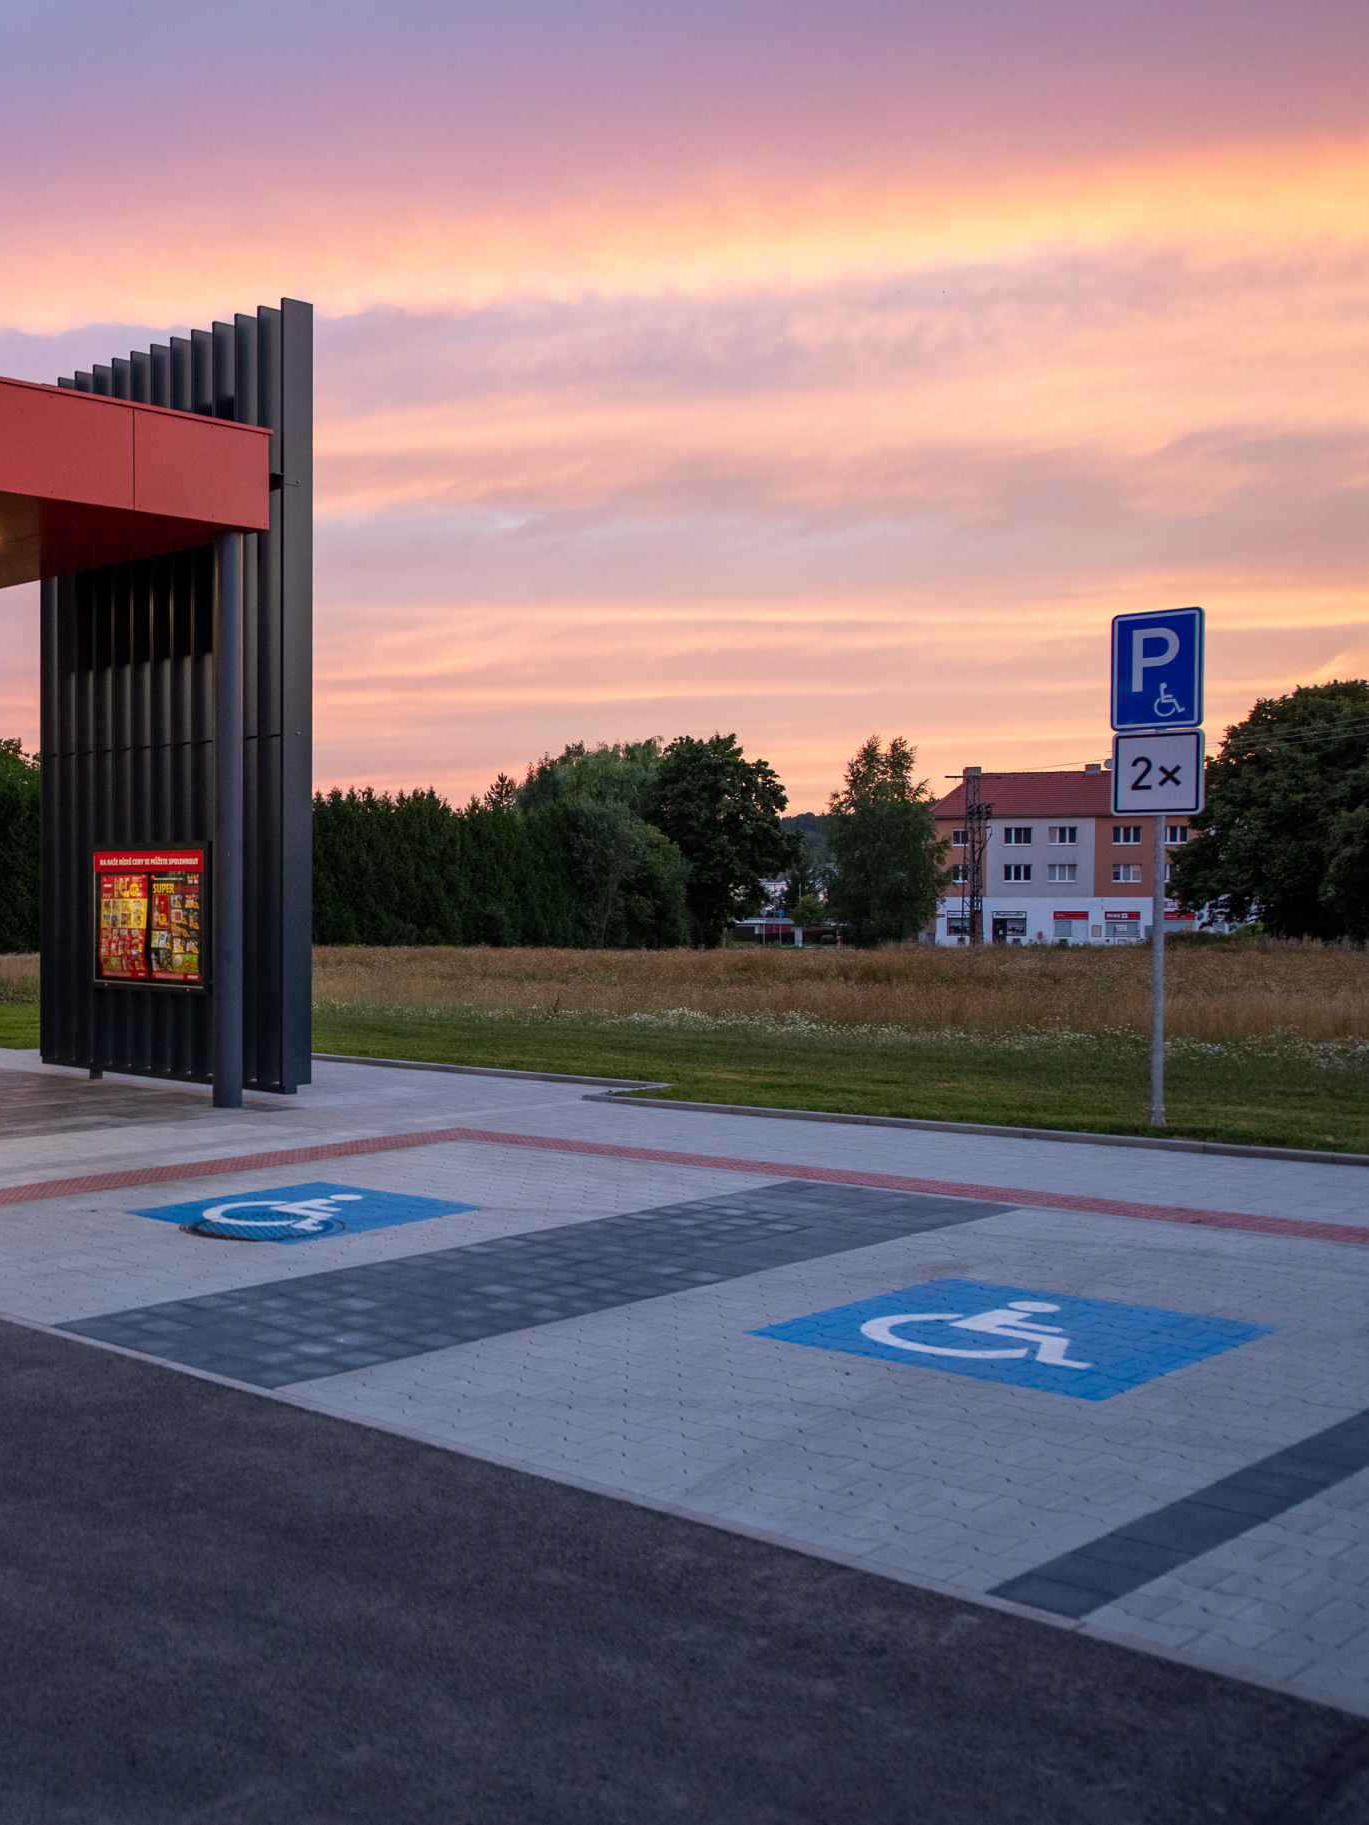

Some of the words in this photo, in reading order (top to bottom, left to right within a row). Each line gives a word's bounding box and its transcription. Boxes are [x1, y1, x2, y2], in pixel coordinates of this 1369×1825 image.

[1132, 627, 1180, 693] P
[107, 858, 119, 866] NAŠE
[119, 857, 132, 866] NÍZKÉ
[150, 857, 168, 865] MŮŽETE
[152, 883, 175, 894] SUPER
